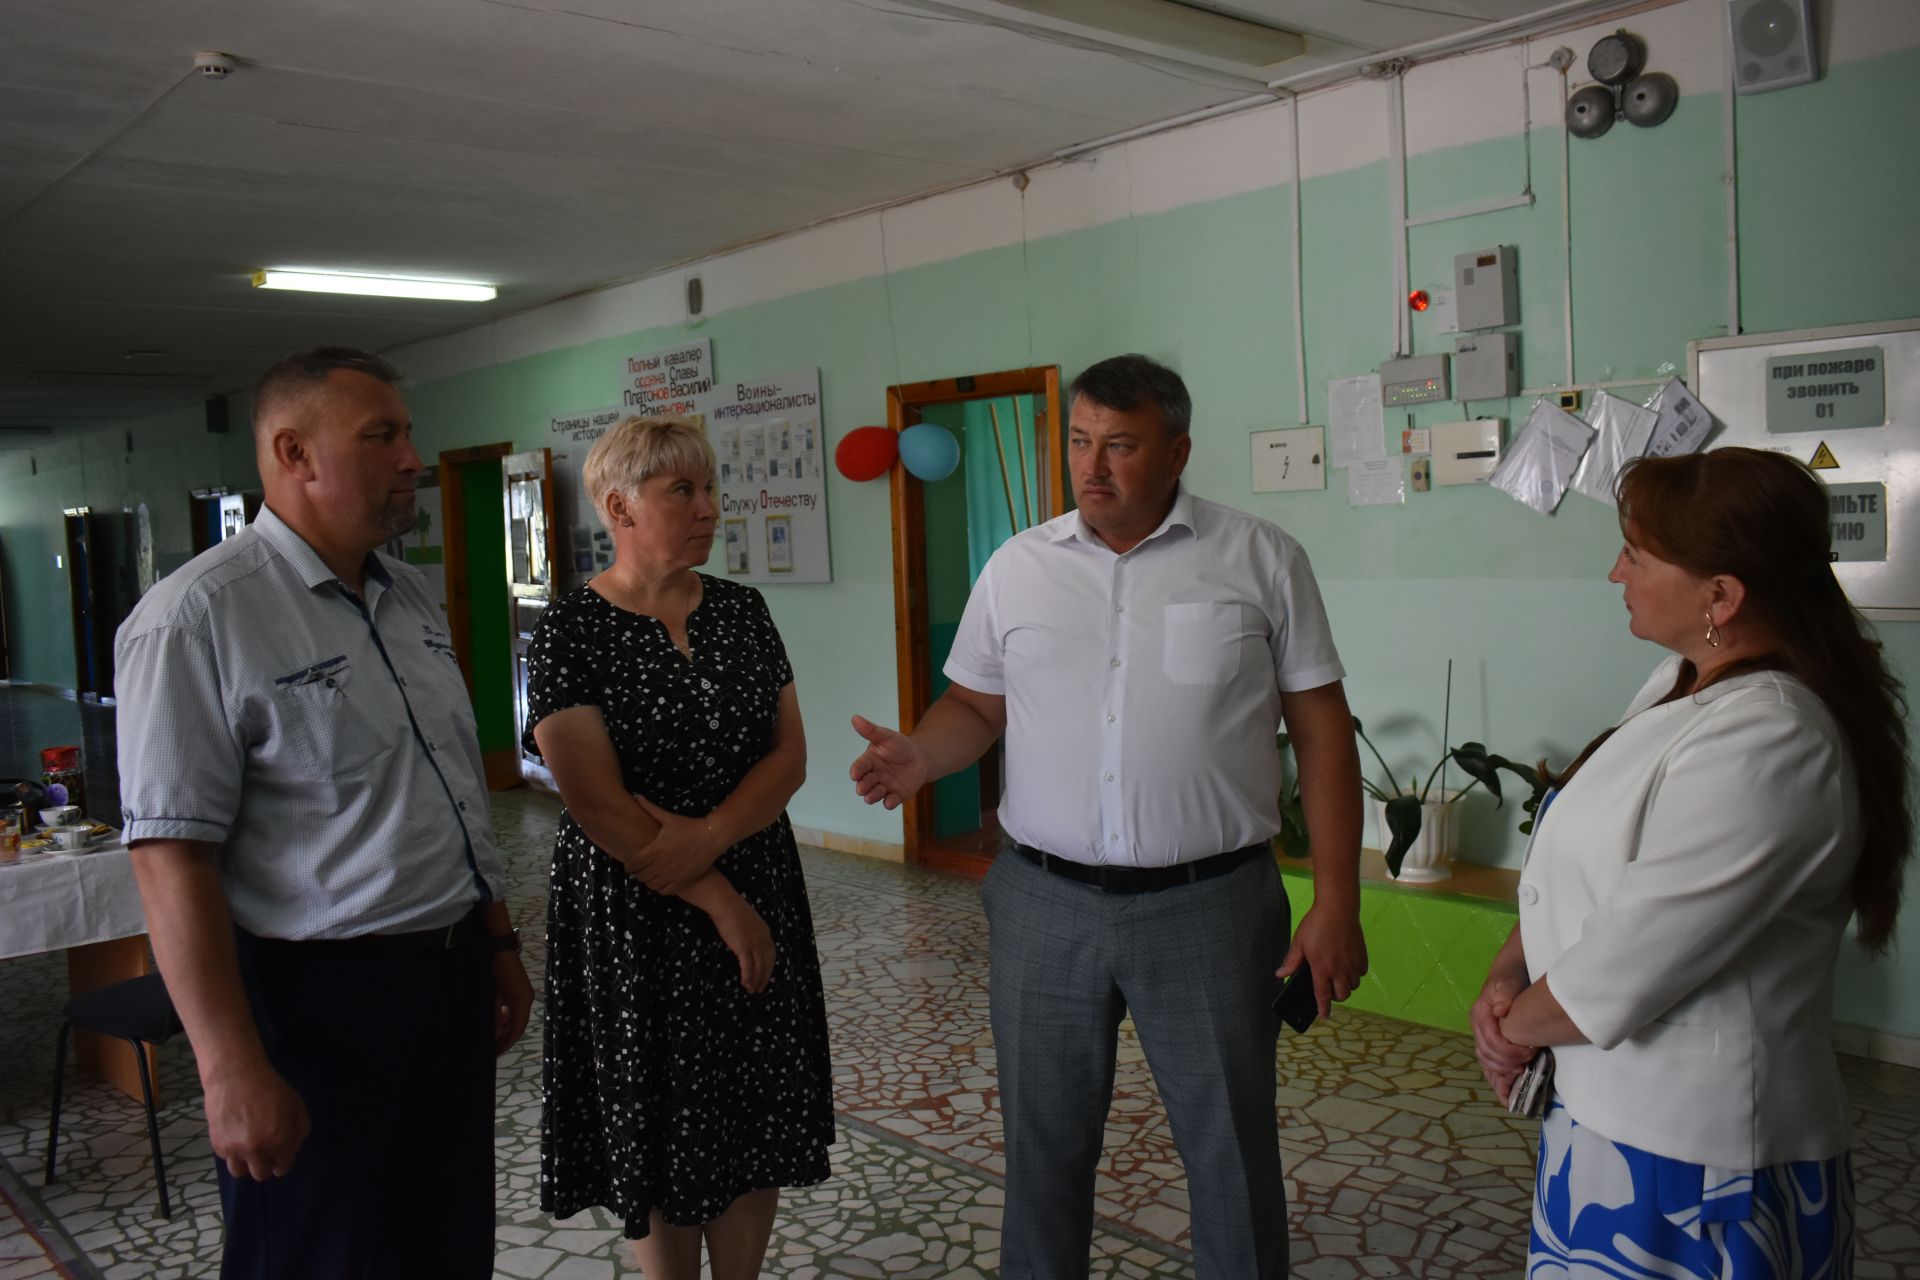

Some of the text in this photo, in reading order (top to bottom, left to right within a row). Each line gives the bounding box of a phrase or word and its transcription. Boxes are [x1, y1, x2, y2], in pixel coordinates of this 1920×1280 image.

[628, 348, 702, 373] Полный кавалер
[1772, 358, 1876, 380] при пожаре
[634, 366, 699, 390] ордена Славы
[624, 377, 711, 407] Платонов Василий
[737, 384, 782, 401] Воины-
[1787, 382, 1860, 399] звонить
[714, 393, 817, 419] интернационалисты
[1815, 403, 1834, 418] 01
[551, 416, 590, 434] Страницы
[722, 489, 817, 515] Служу Отечеству
